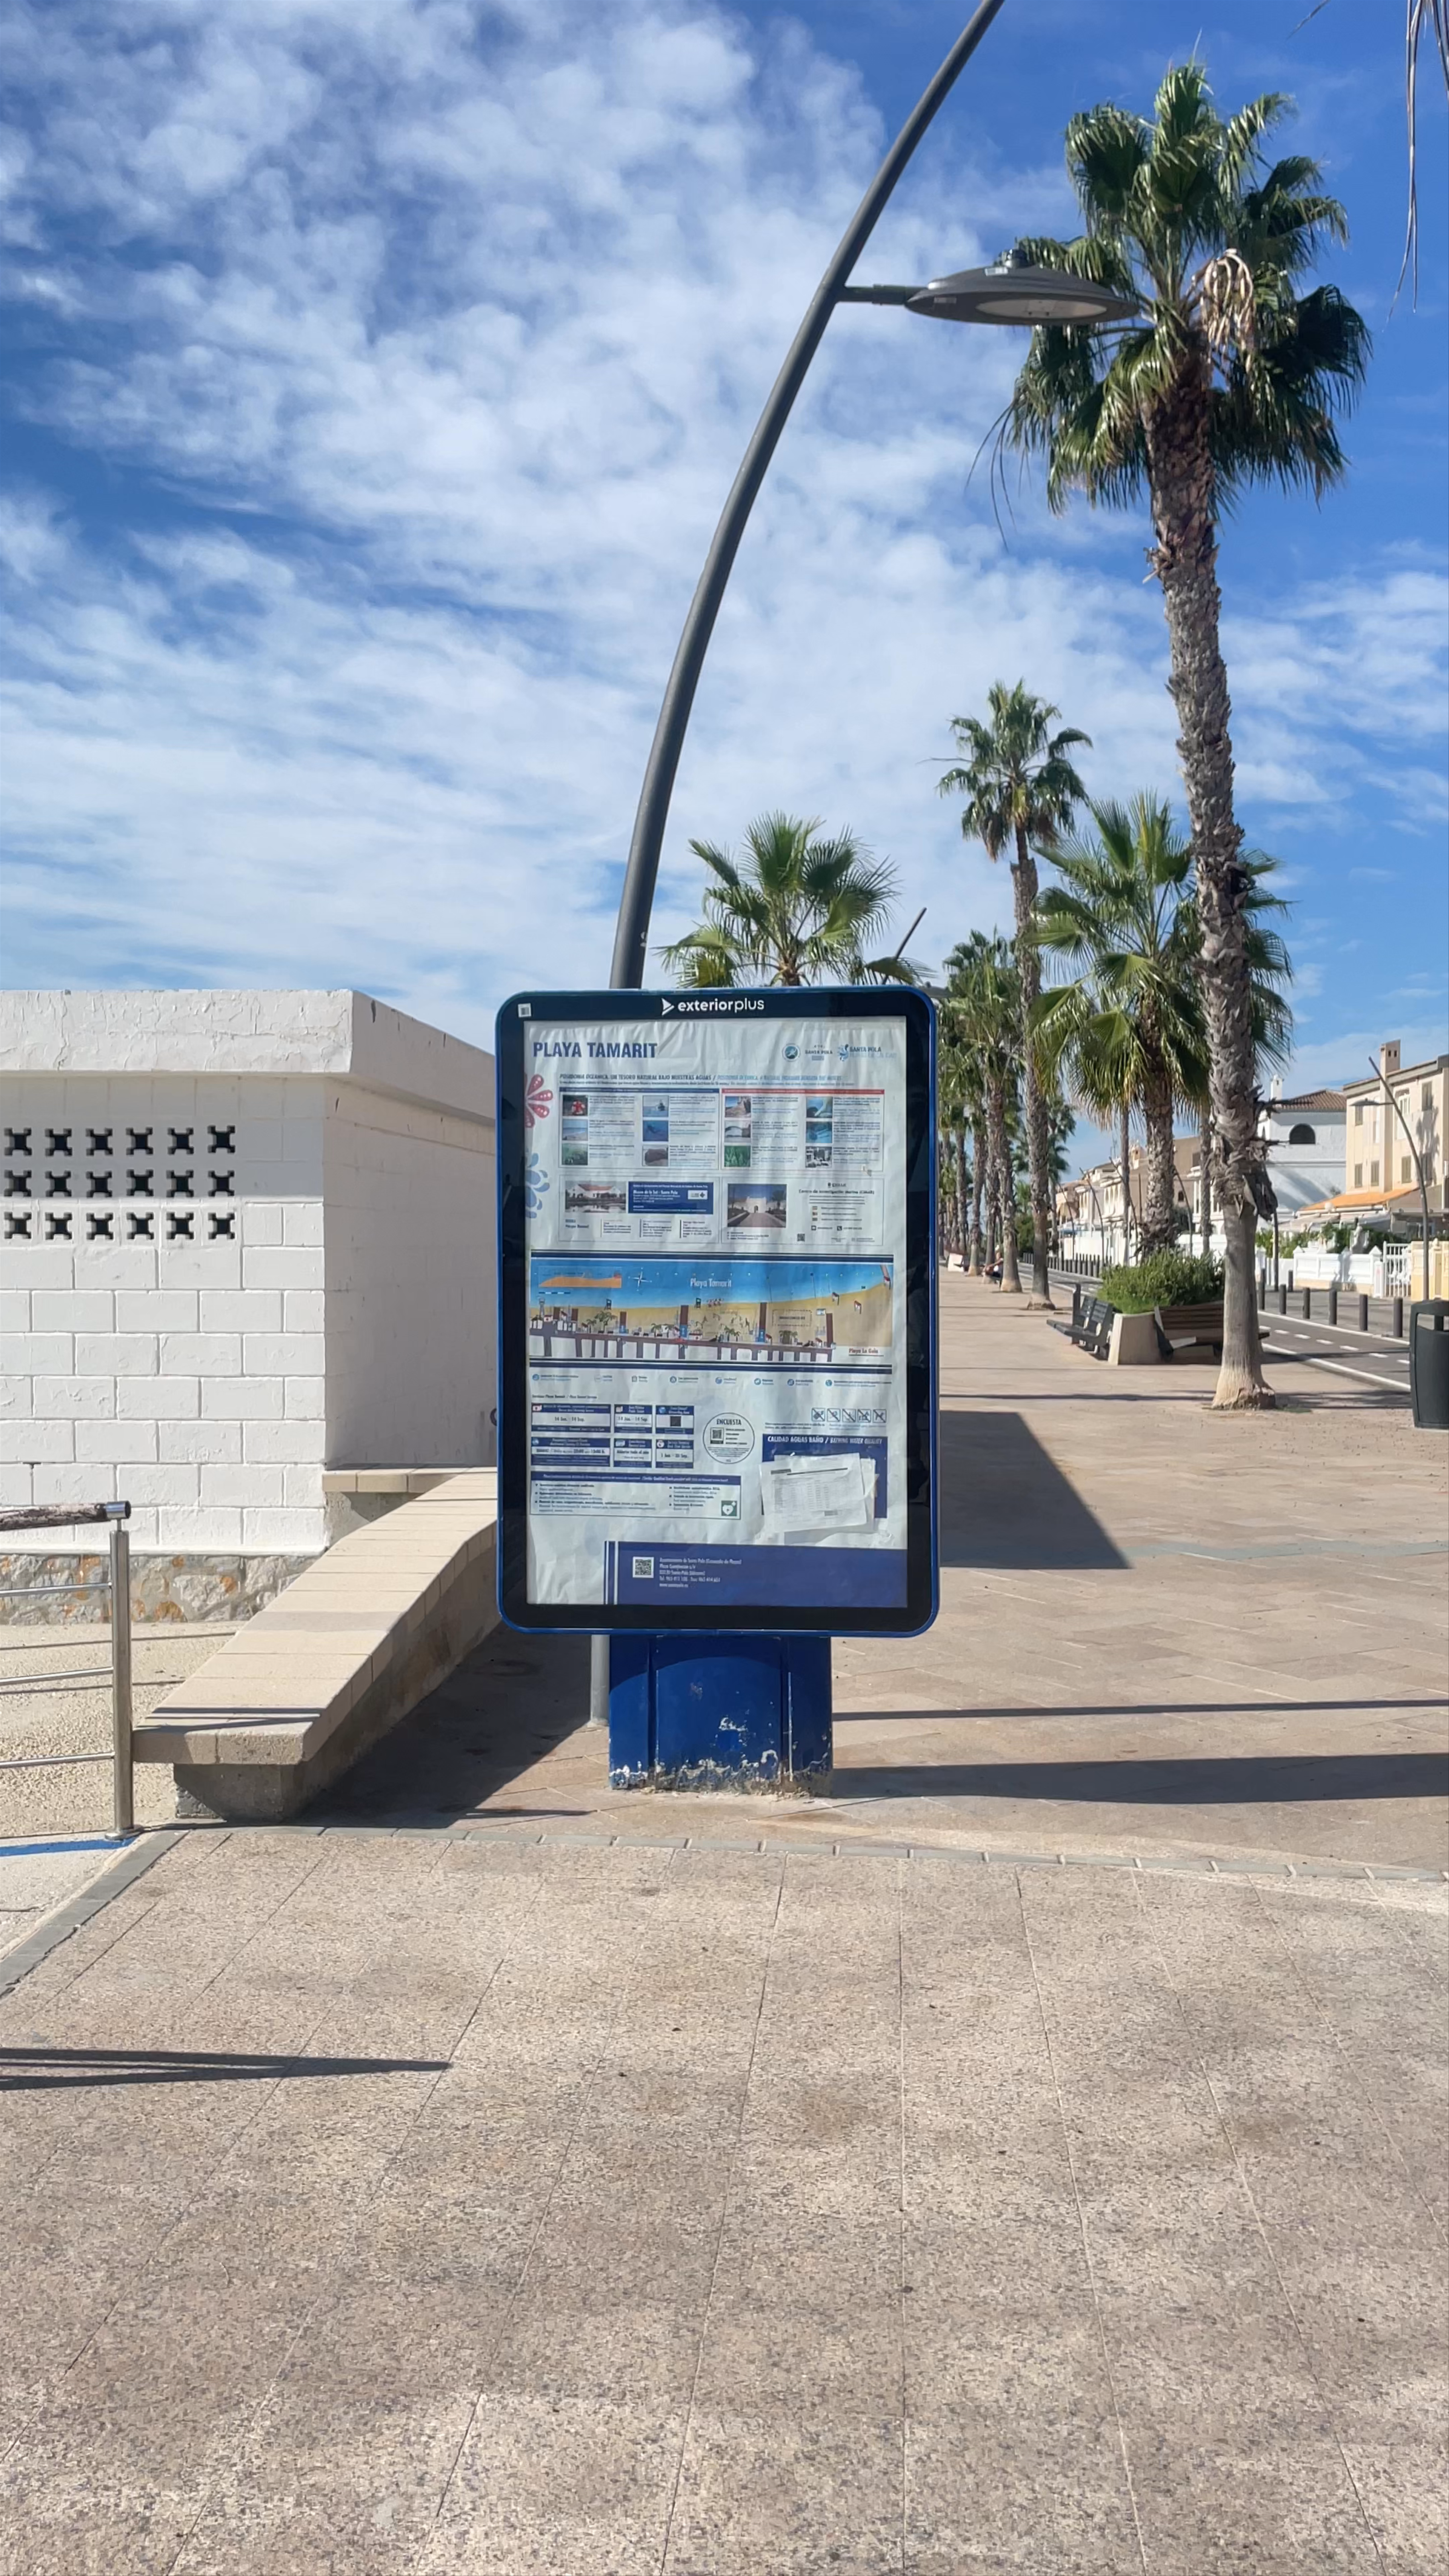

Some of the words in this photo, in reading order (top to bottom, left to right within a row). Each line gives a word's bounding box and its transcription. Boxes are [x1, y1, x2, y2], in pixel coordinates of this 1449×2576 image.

[678, 997, 764, 1013] exteriorplus
[533, 1042, 582, 1057] PLAYA
[587, 1043, 658, 1058] TAMARIT
[690, 1278, 708, 1289] Playa
[708, 1278, 732, 1287] Tamarit
